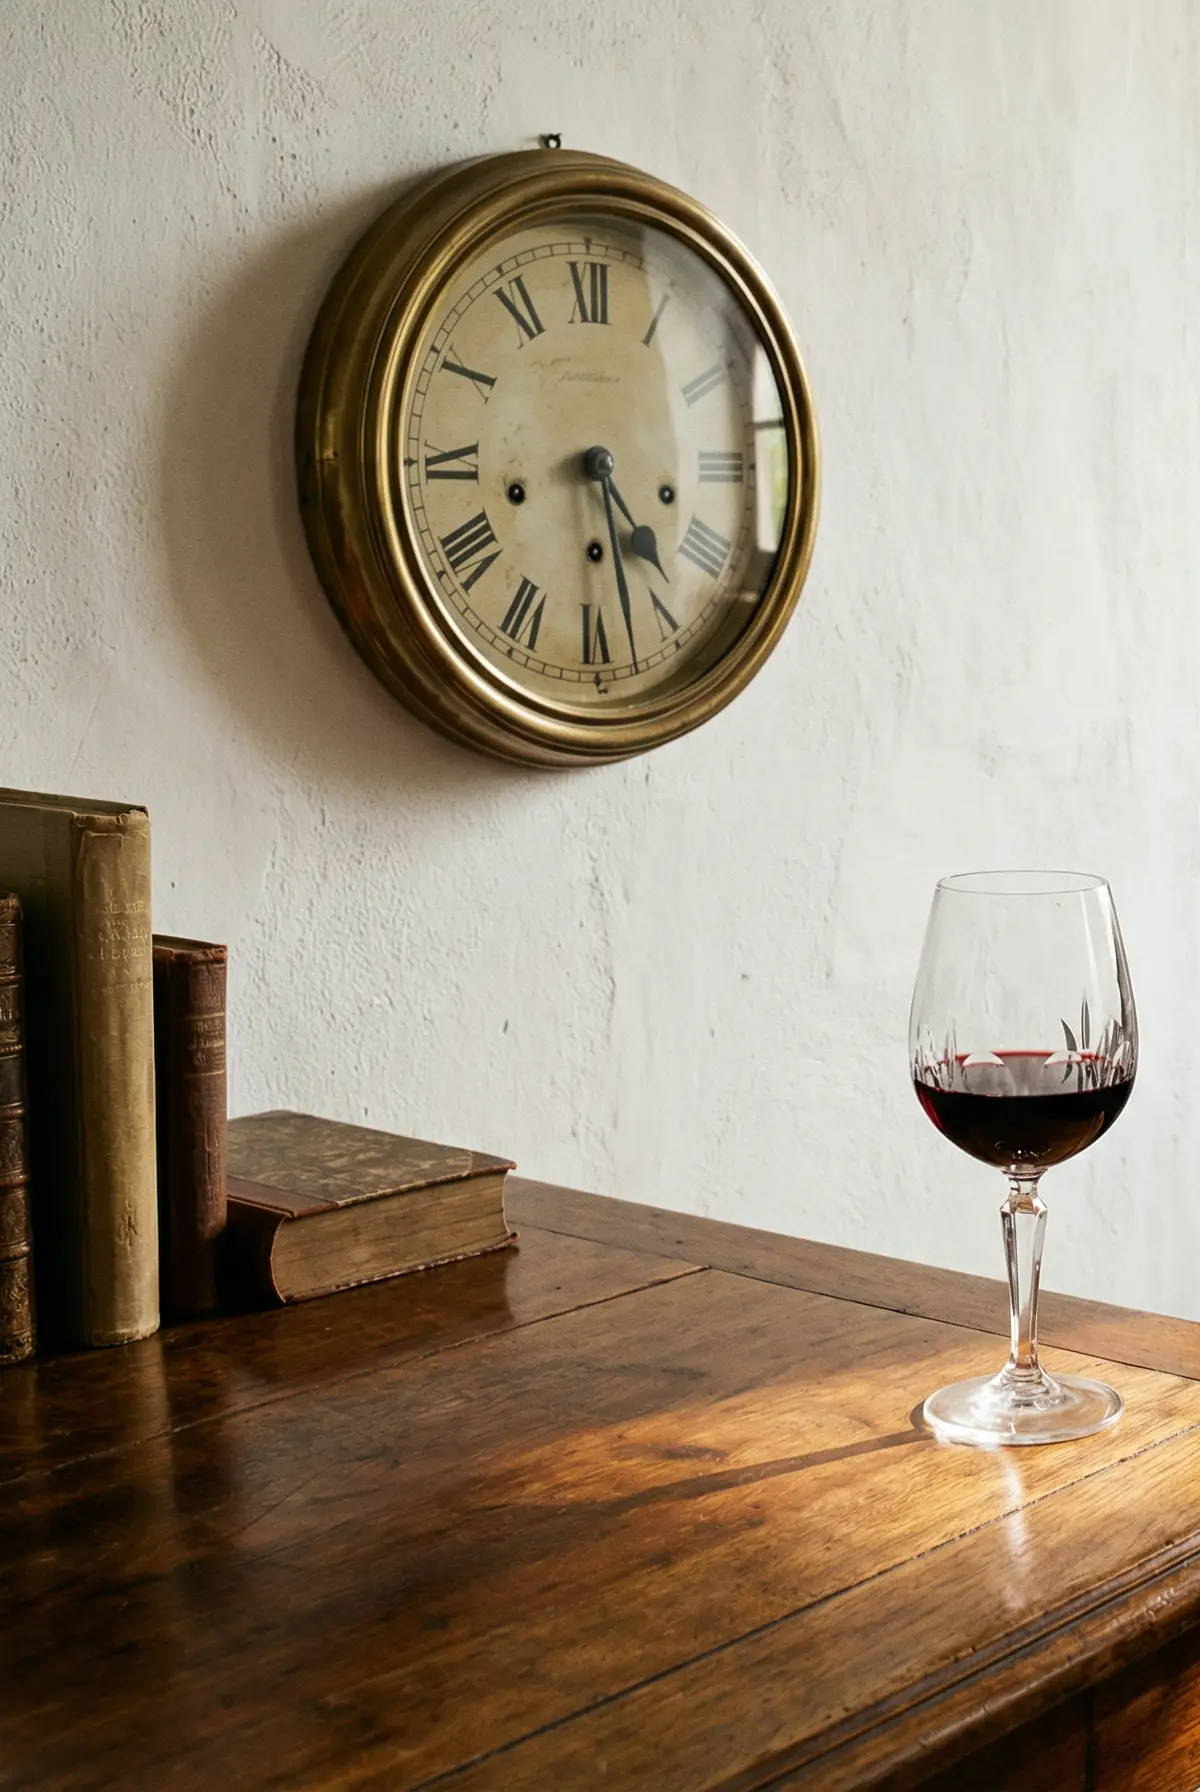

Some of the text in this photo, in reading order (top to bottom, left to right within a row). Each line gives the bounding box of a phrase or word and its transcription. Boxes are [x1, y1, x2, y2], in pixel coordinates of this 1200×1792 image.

[492, 274, 546, 349] XI
[566, 261, 611, 325] XII
[641, 293, 670, 348] I
[439, 342, 498, 405] X
[680, 360, 727, 408] II
[424, 439, 479, 485] IX
[697, 450, 744, 486] III
[438, 507, 504, 597] VIII
[678, 514, 732, 582] IIII
[497, 573, 547, 653] VII
[580, 603, 614, 665] VI
[648, 586, 682, 643] V
